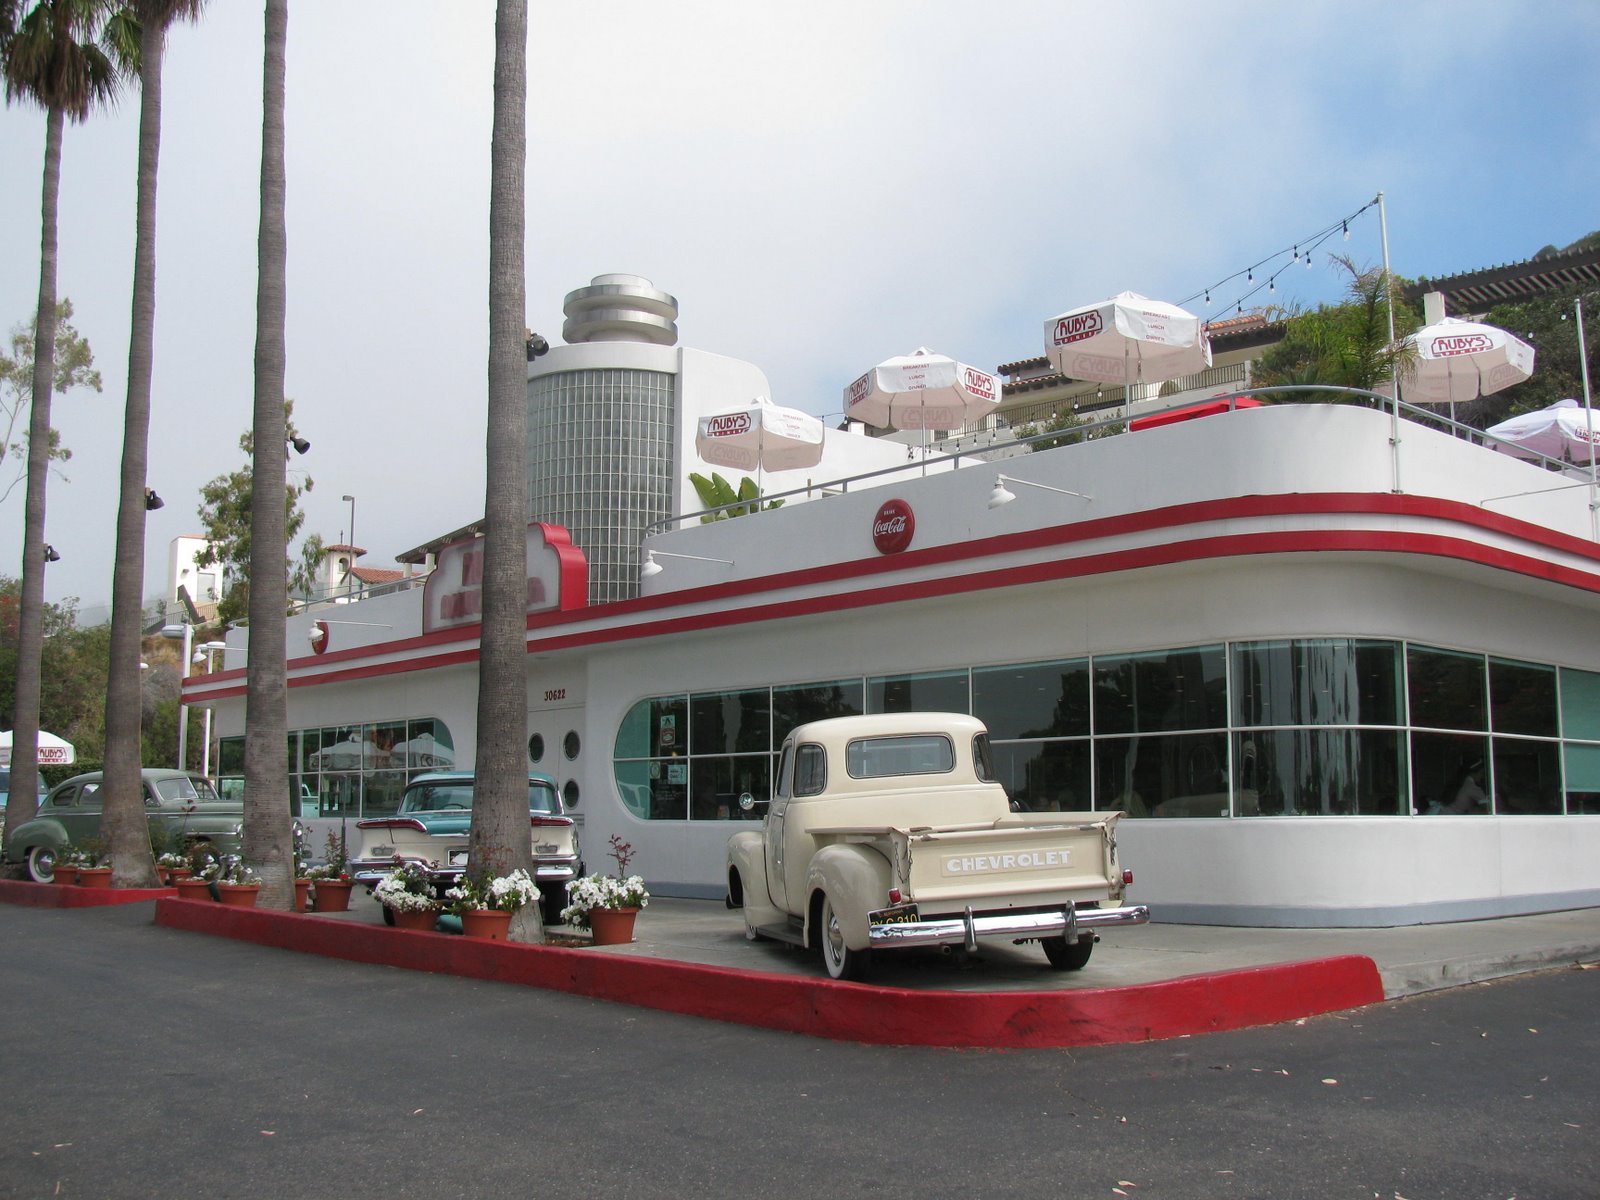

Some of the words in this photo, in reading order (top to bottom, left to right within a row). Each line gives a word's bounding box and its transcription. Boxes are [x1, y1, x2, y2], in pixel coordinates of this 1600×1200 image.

[1060, 313, 1097, 336] RUBY'S
[1438, 336, 1485, 351] RUBY'S
[967, 371, 992, 391] RUBY'S
[712, 415, 747, 431] RUBY'S
[544, 688, 566, 702] 30622
[39, 748, 64, 758] RUBY'S
[946, 850, 1071, 872] CHEVROLET
